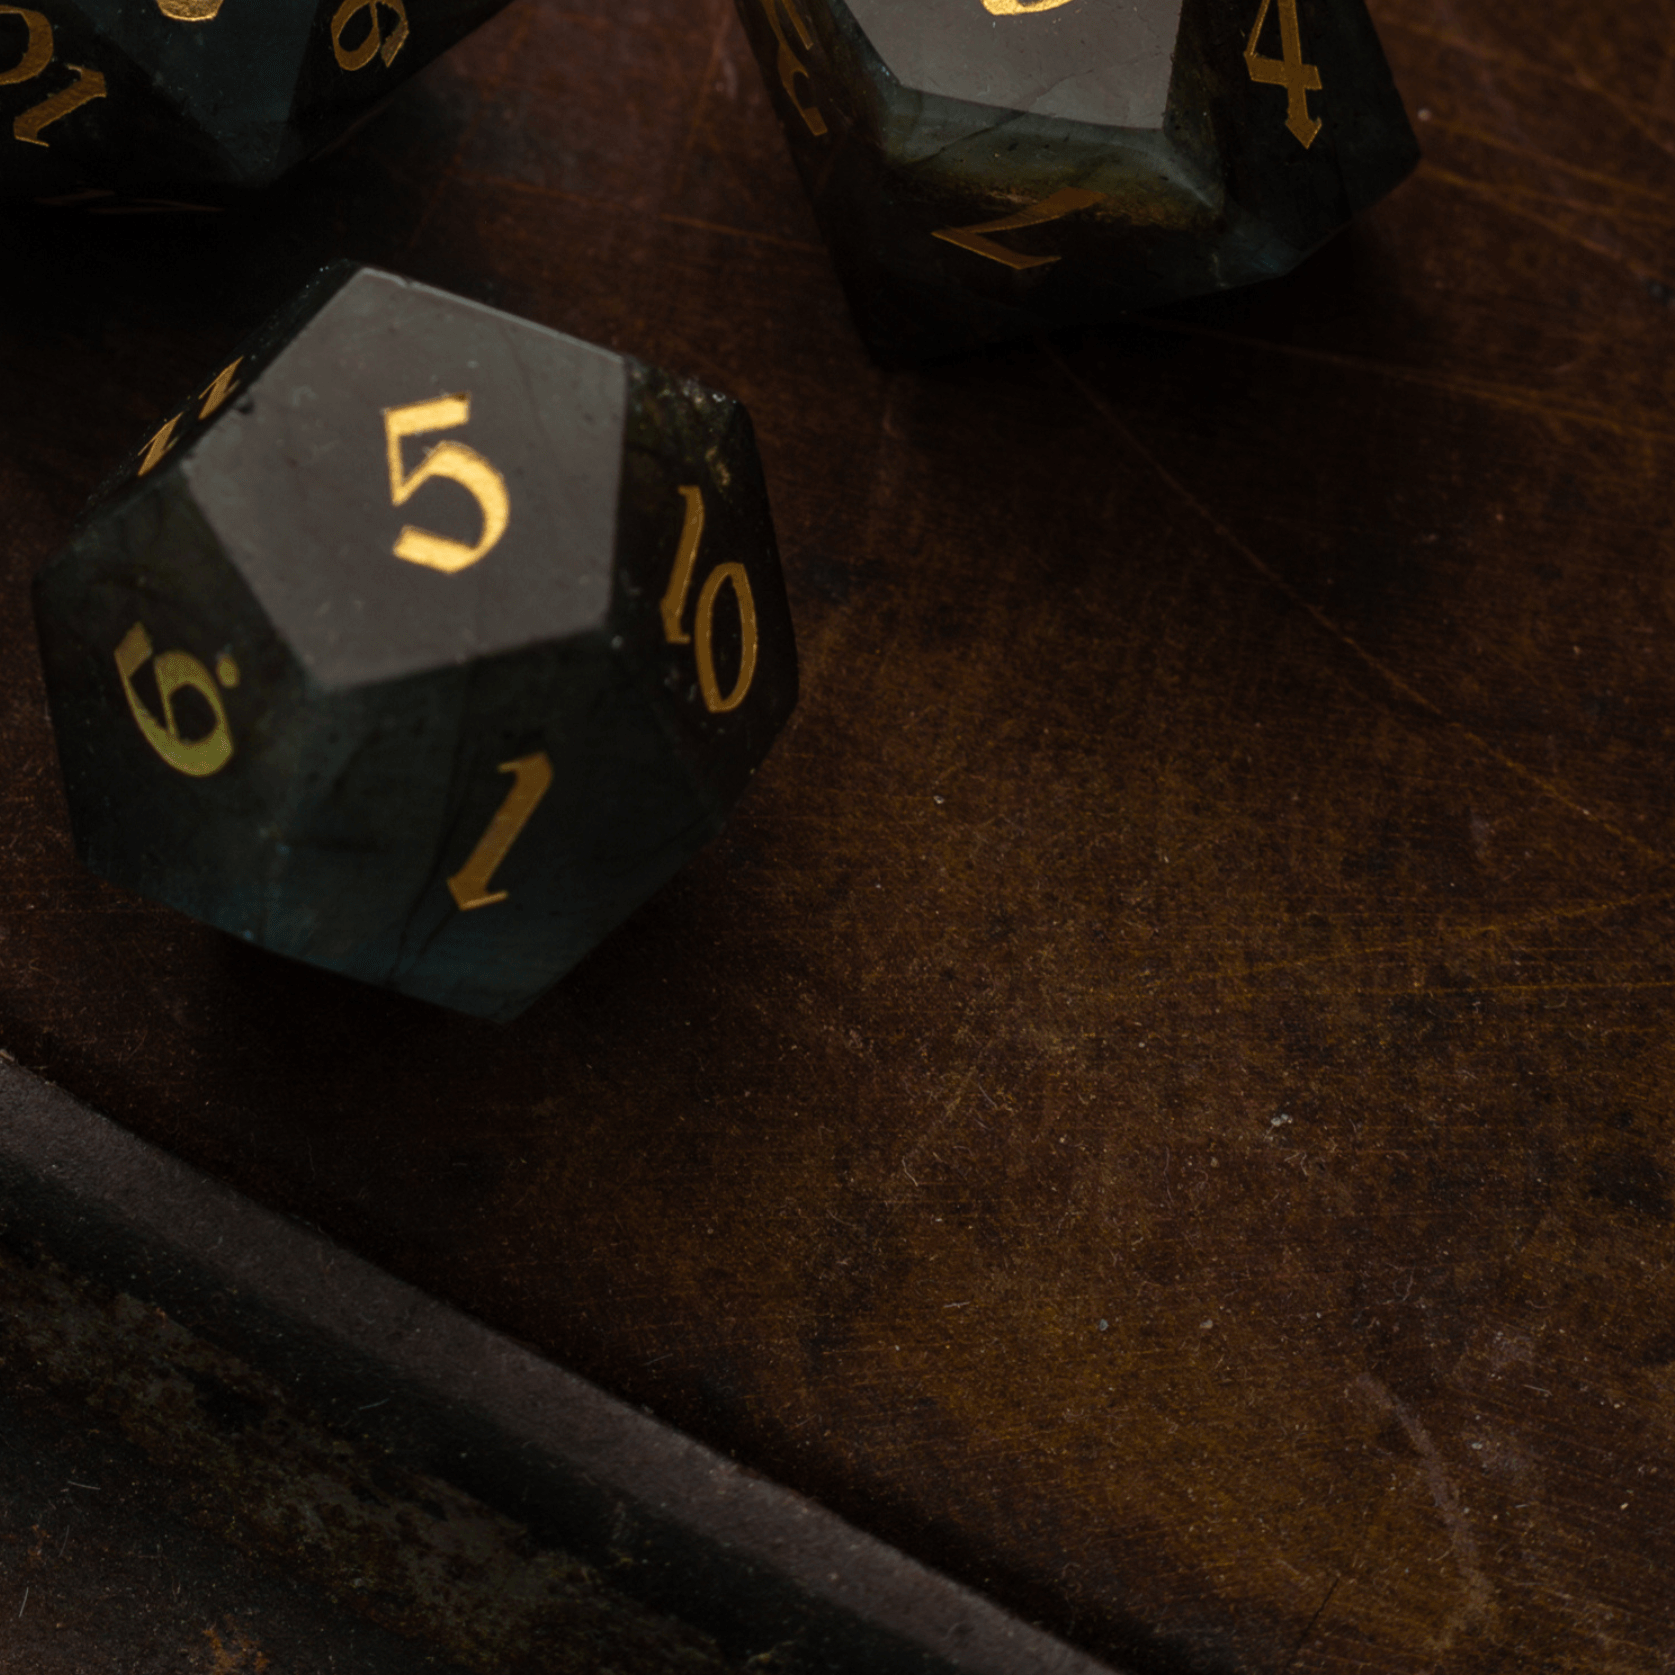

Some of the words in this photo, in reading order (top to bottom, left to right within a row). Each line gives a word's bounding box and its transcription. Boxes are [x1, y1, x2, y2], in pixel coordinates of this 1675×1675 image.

[382, 391, 511, 574] 5
[660, 484, 759, 713] 10
[446, 751, 555, 911] 1
